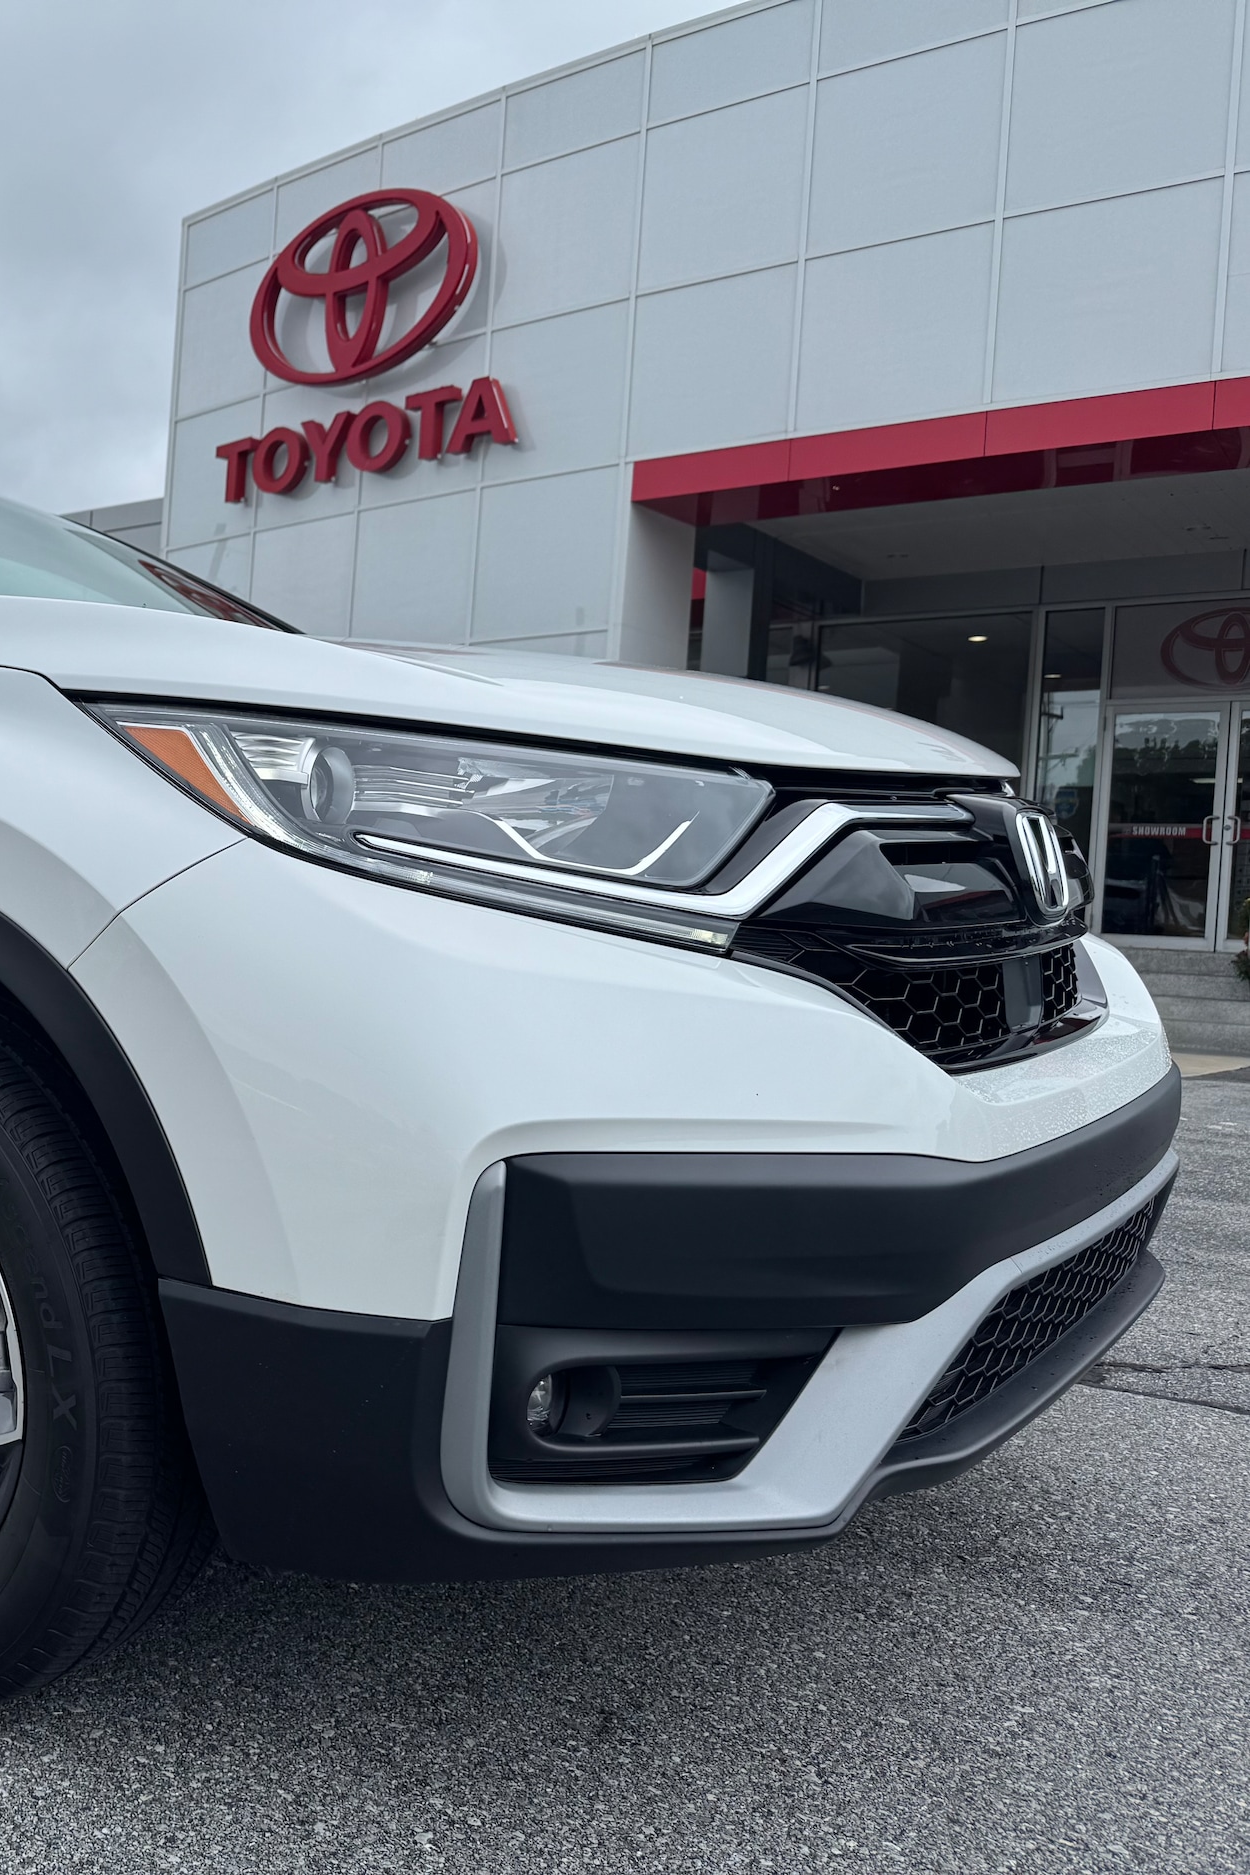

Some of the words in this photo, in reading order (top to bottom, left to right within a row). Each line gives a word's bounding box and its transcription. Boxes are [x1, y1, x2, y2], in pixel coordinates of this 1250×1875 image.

[216, 376, 518, 503] TOYOTA
[1132, 826, 1187, 836] SHOWROOM
[47, 1343, 78, 1431] LX
